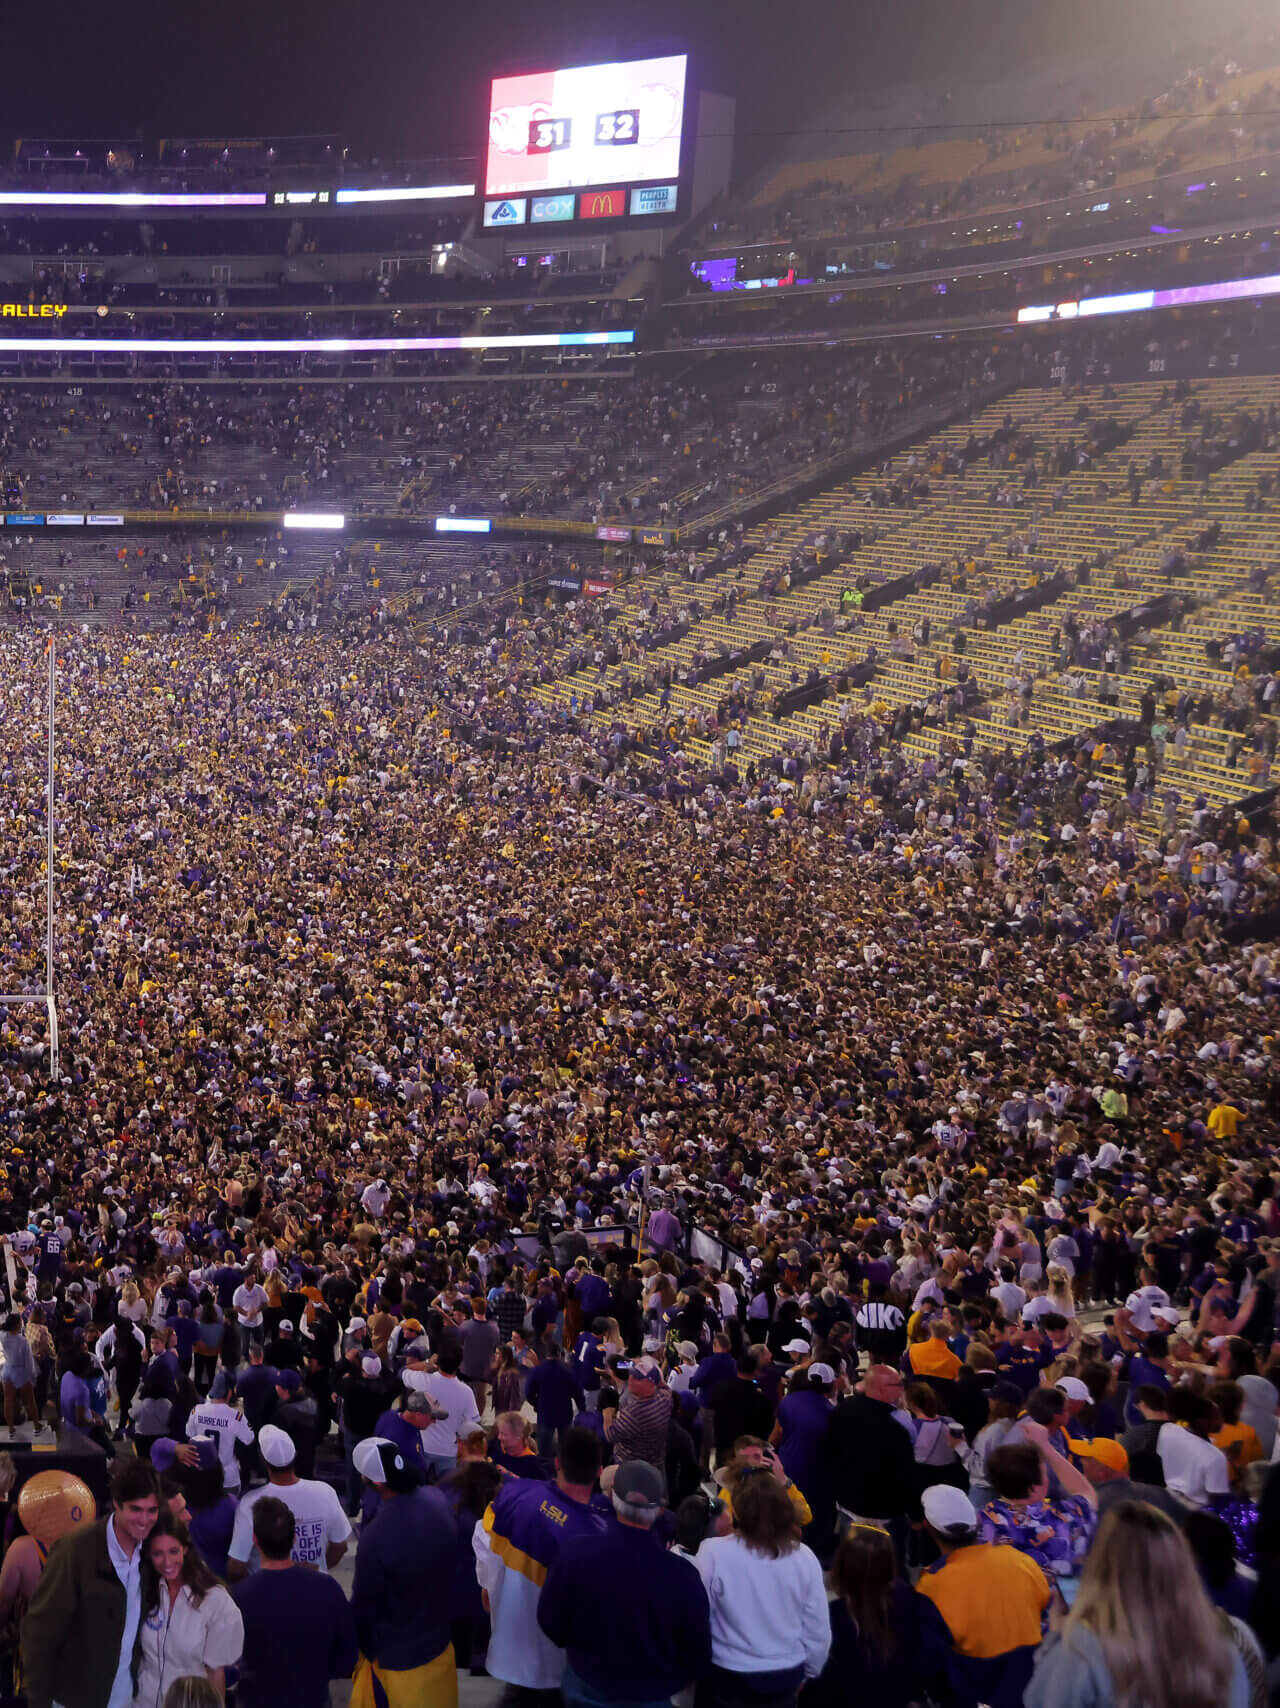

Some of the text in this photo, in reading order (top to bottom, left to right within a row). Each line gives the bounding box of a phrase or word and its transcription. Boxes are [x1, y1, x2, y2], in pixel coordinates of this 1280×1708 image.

[535, 121, 564, 147] 31
[597, 114, 634, 140] 32
[534, 200, 573, 217] COX
[1147, 359, 1166, 372] 101
[1240, 1224, 1249, 1242] 1
[47, 1241, 60, 1254] 66
[578, 1341, 589, 1363] 1
[198, 1415, 229, 1428] BURREAUX
[539, 1499, 569, 1523] LSU
[312, 1524, 322, 1537] IS
[299, 1537, 322, 1551] OFF
